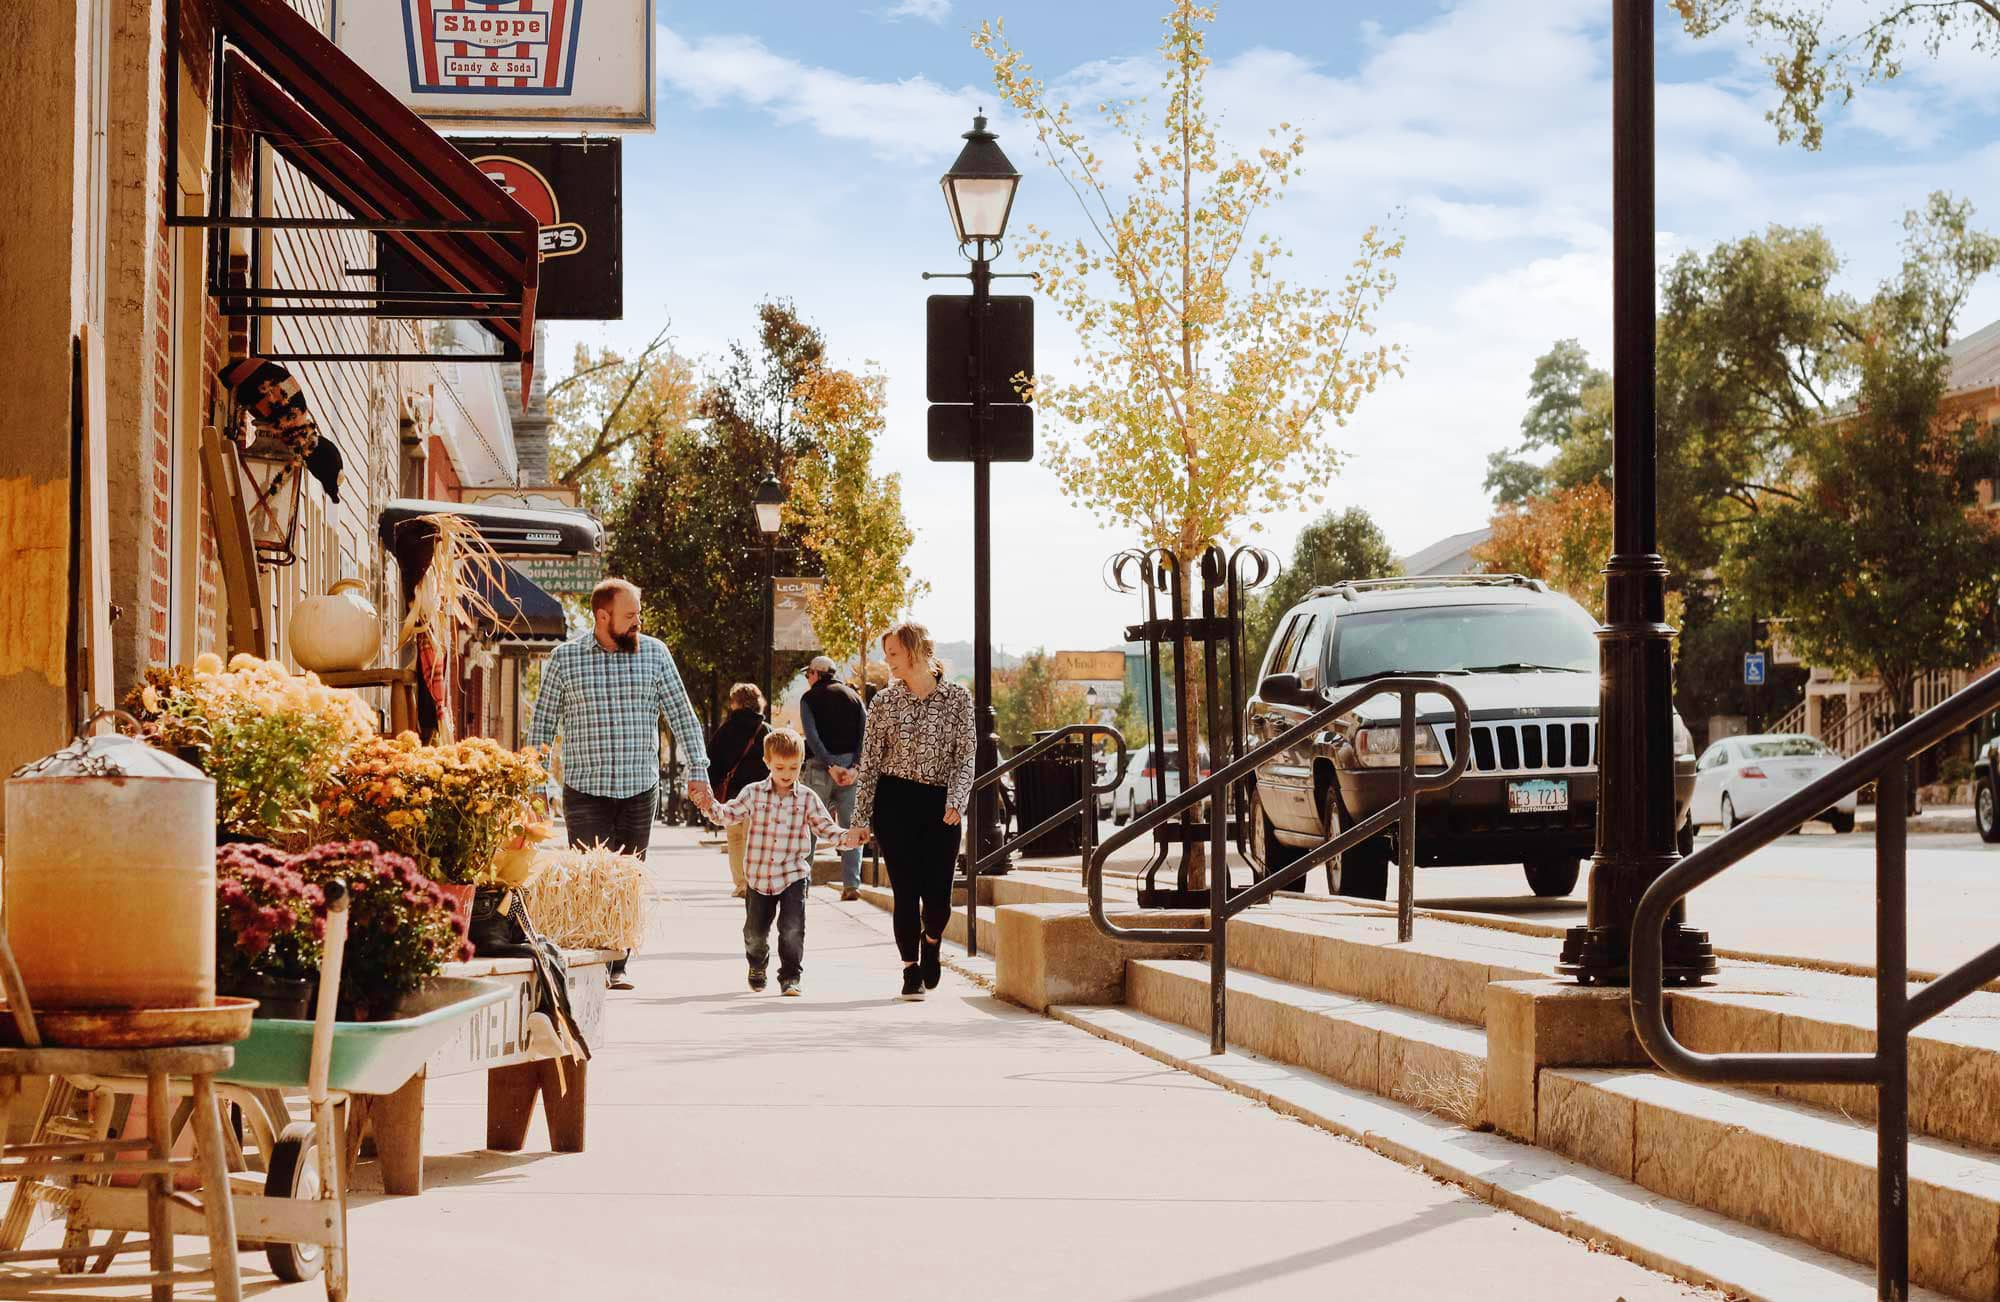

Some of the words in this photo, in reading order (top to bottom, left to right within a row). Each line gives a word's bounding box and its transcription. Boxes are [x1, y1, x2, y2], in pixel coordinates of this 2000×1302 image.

[443, 15, 541, 37] Shoppe
[450, 61, 482, 74] Candy
[490, 62, 499, 72] &
[507, 62, 532, 73] Soda
[1538, 788, 1567, 804] 7213
